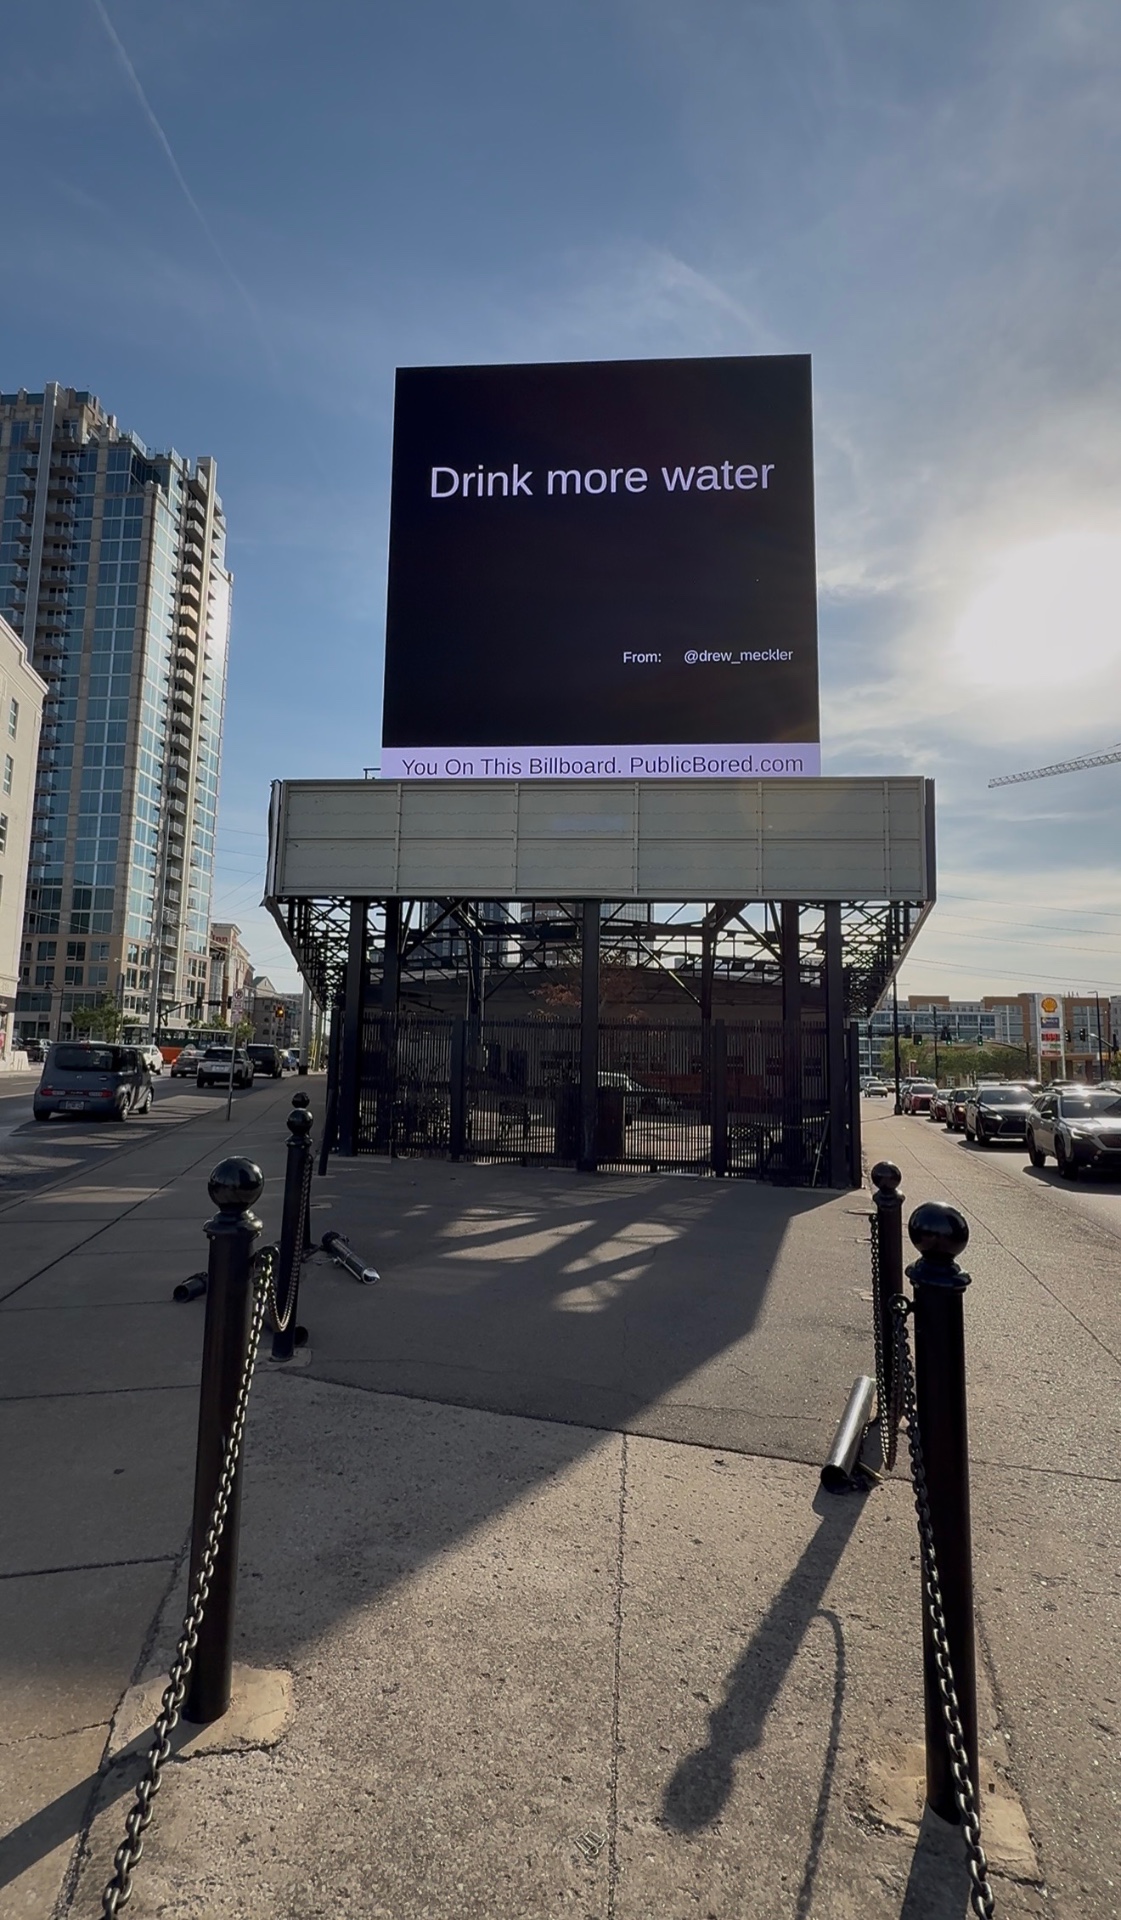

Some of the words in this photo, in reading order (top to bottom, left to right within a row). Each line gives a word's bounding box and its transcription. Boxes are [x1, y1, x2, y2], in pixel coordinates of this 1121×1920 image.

[430, 463, 534, 499] Drink
[546, 467, 649, 496] more
[660, 459, 776, 493] water
[622, 651, 662, 664] From:
[683, 648, 794, 666] @drew_meckler
[401, 757, 439, 777] You
[444, 757, 475, 776] On
[480, 756, 523, 776] This
[528, 755, 623, 775] Billboard.
[629, 754, 804, 775] PublicBored.com
